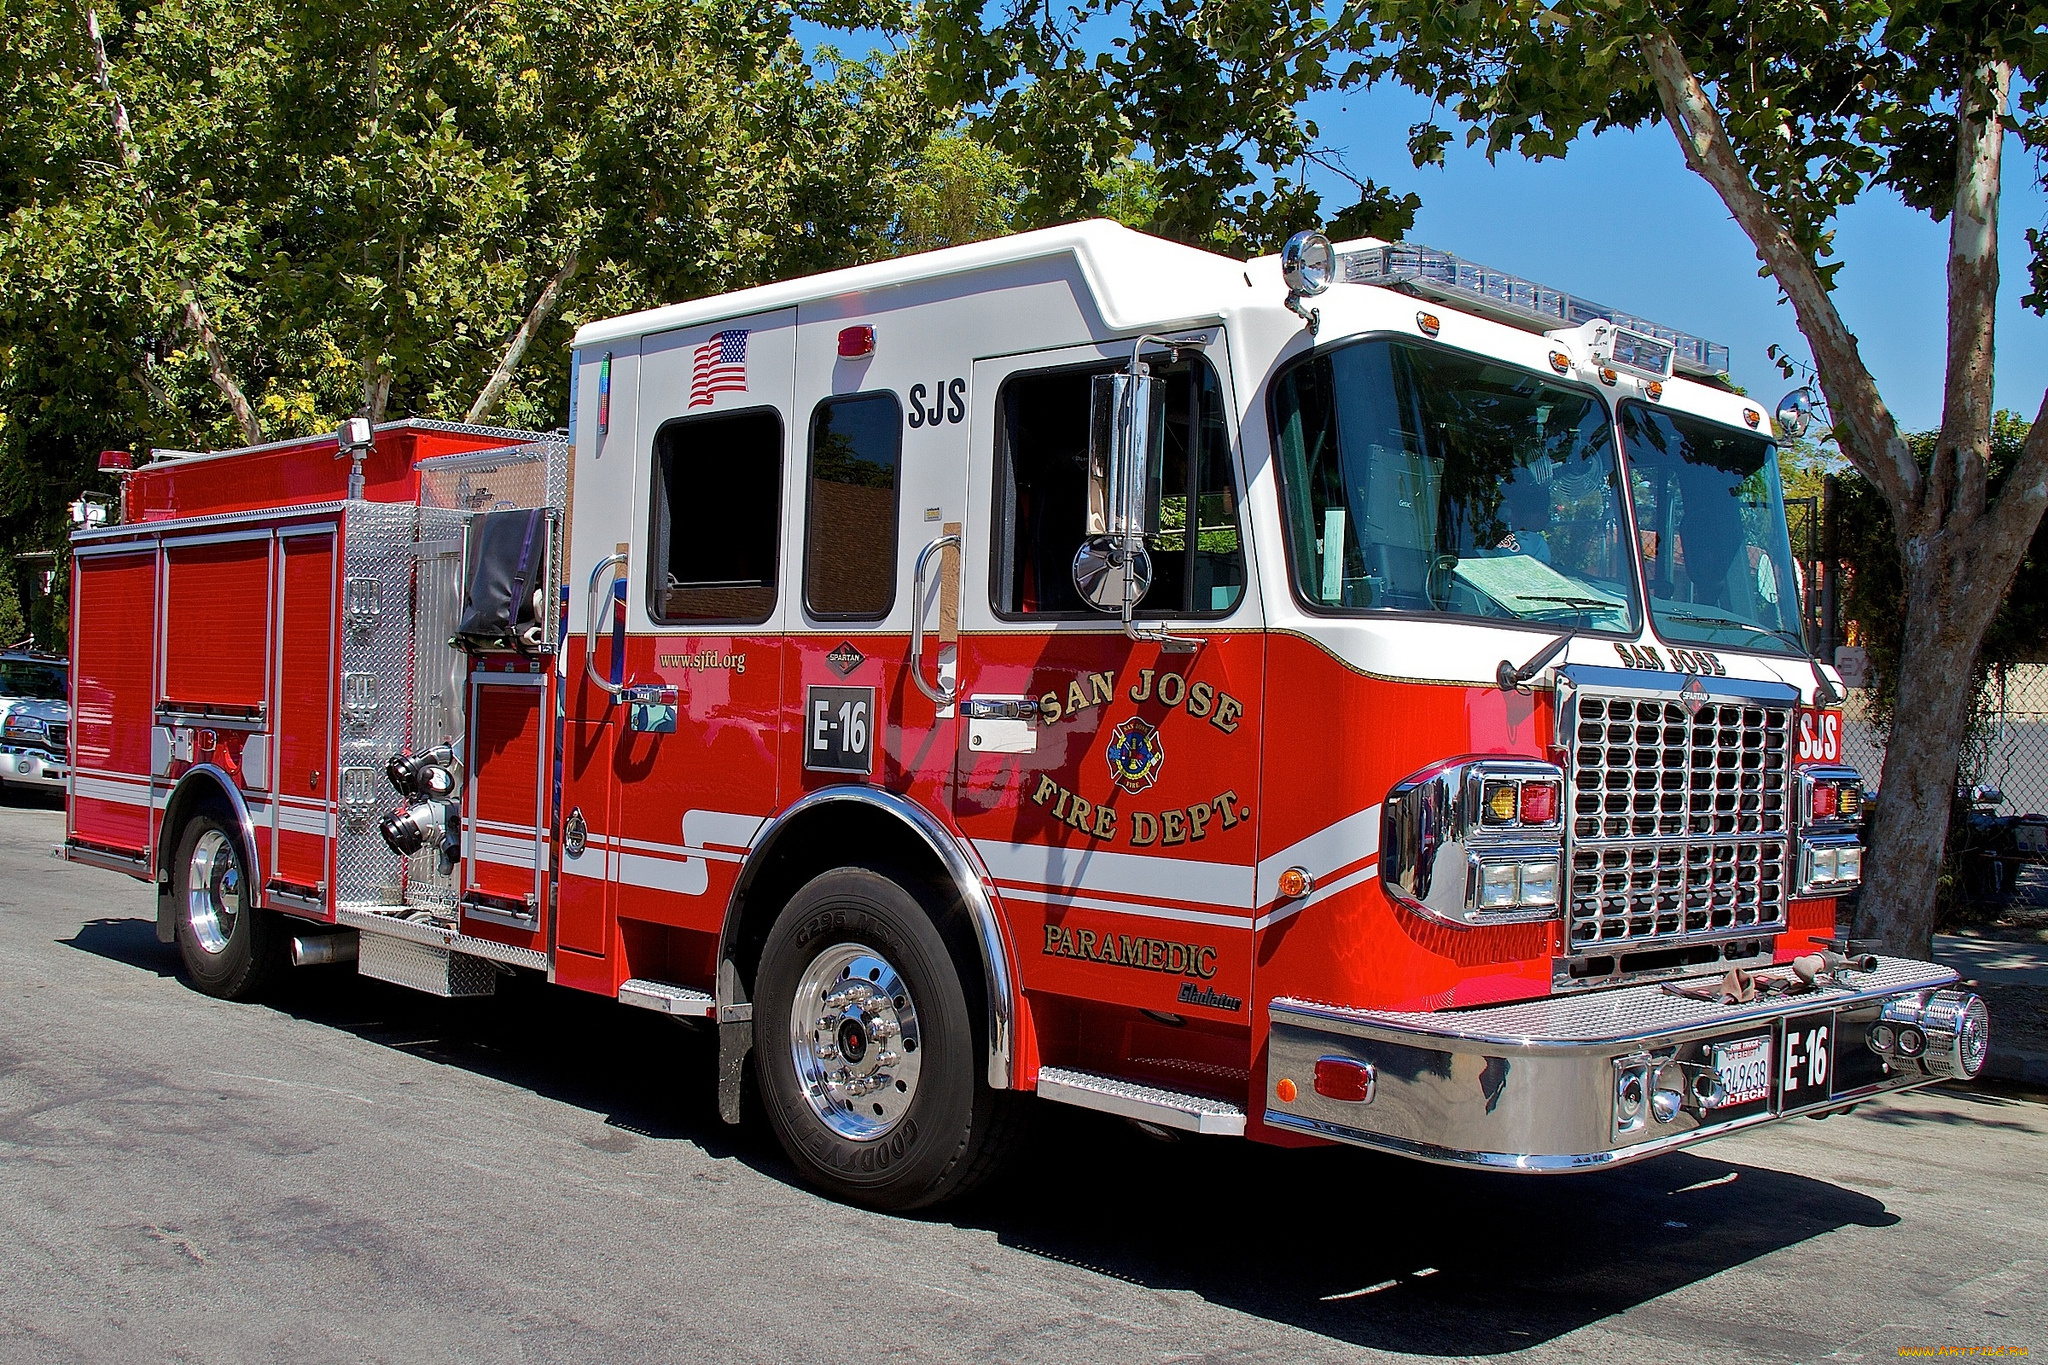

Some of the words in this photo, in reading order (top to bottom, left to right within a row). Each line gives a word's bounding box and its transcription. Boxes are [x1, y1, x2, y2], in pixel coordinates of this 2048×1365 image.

[908, 377, 966, 428] SJS
[659, 650, 746, 674] www.sjfd.org
[829, 653, 860, 661] SPARTAN
[1613, 643, 1665, 671] SAN
[1666, 648, 1726, 676] JOSE
[1039, 671, 1115, 726] SAN
[1130, 669, 1243, 734] JOSE
[1682, 691, 1708, 701] SPARTAN
[813, 700, 867, 753] E-16
[1800, 712, 1837, 760] SJS
[1032, 774, 1117, 839] FIRE
[1130, 791, 1249, 845] DEPT.
[1126, 781, 1140, 789] FIRE
[1043, 924, 1218, 979] PARAMEDIC
[1178, 982, 1242, 1011] Gladiator
[1784, 1026, 1828, 1091] E-16
[782, 1095, 919, 1172] GOODYEAR
